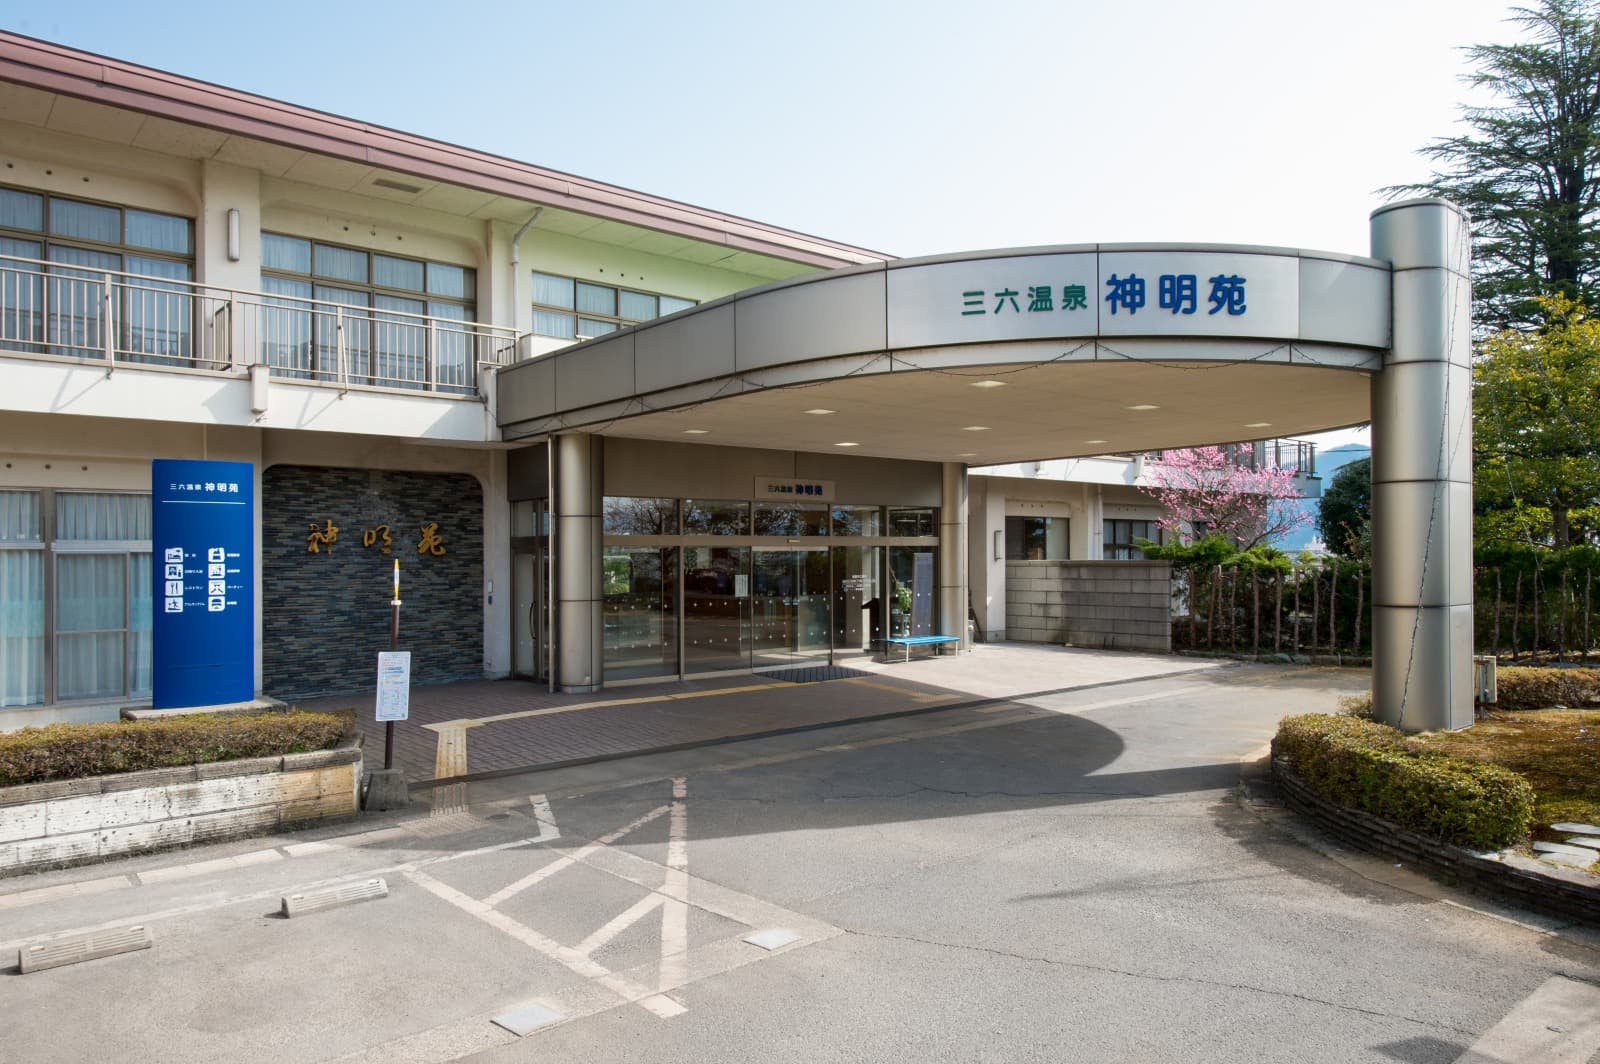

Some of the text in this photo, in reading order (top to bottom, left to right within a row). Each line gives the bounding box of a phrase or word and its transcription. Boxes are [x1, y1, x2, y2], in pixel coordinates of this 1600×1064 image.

[961, 273, 1247, 316] 三六温泉 神明苑
[204, 482, 239, 493] 神明苑
[307, 519, 446, 556] 神明苑
